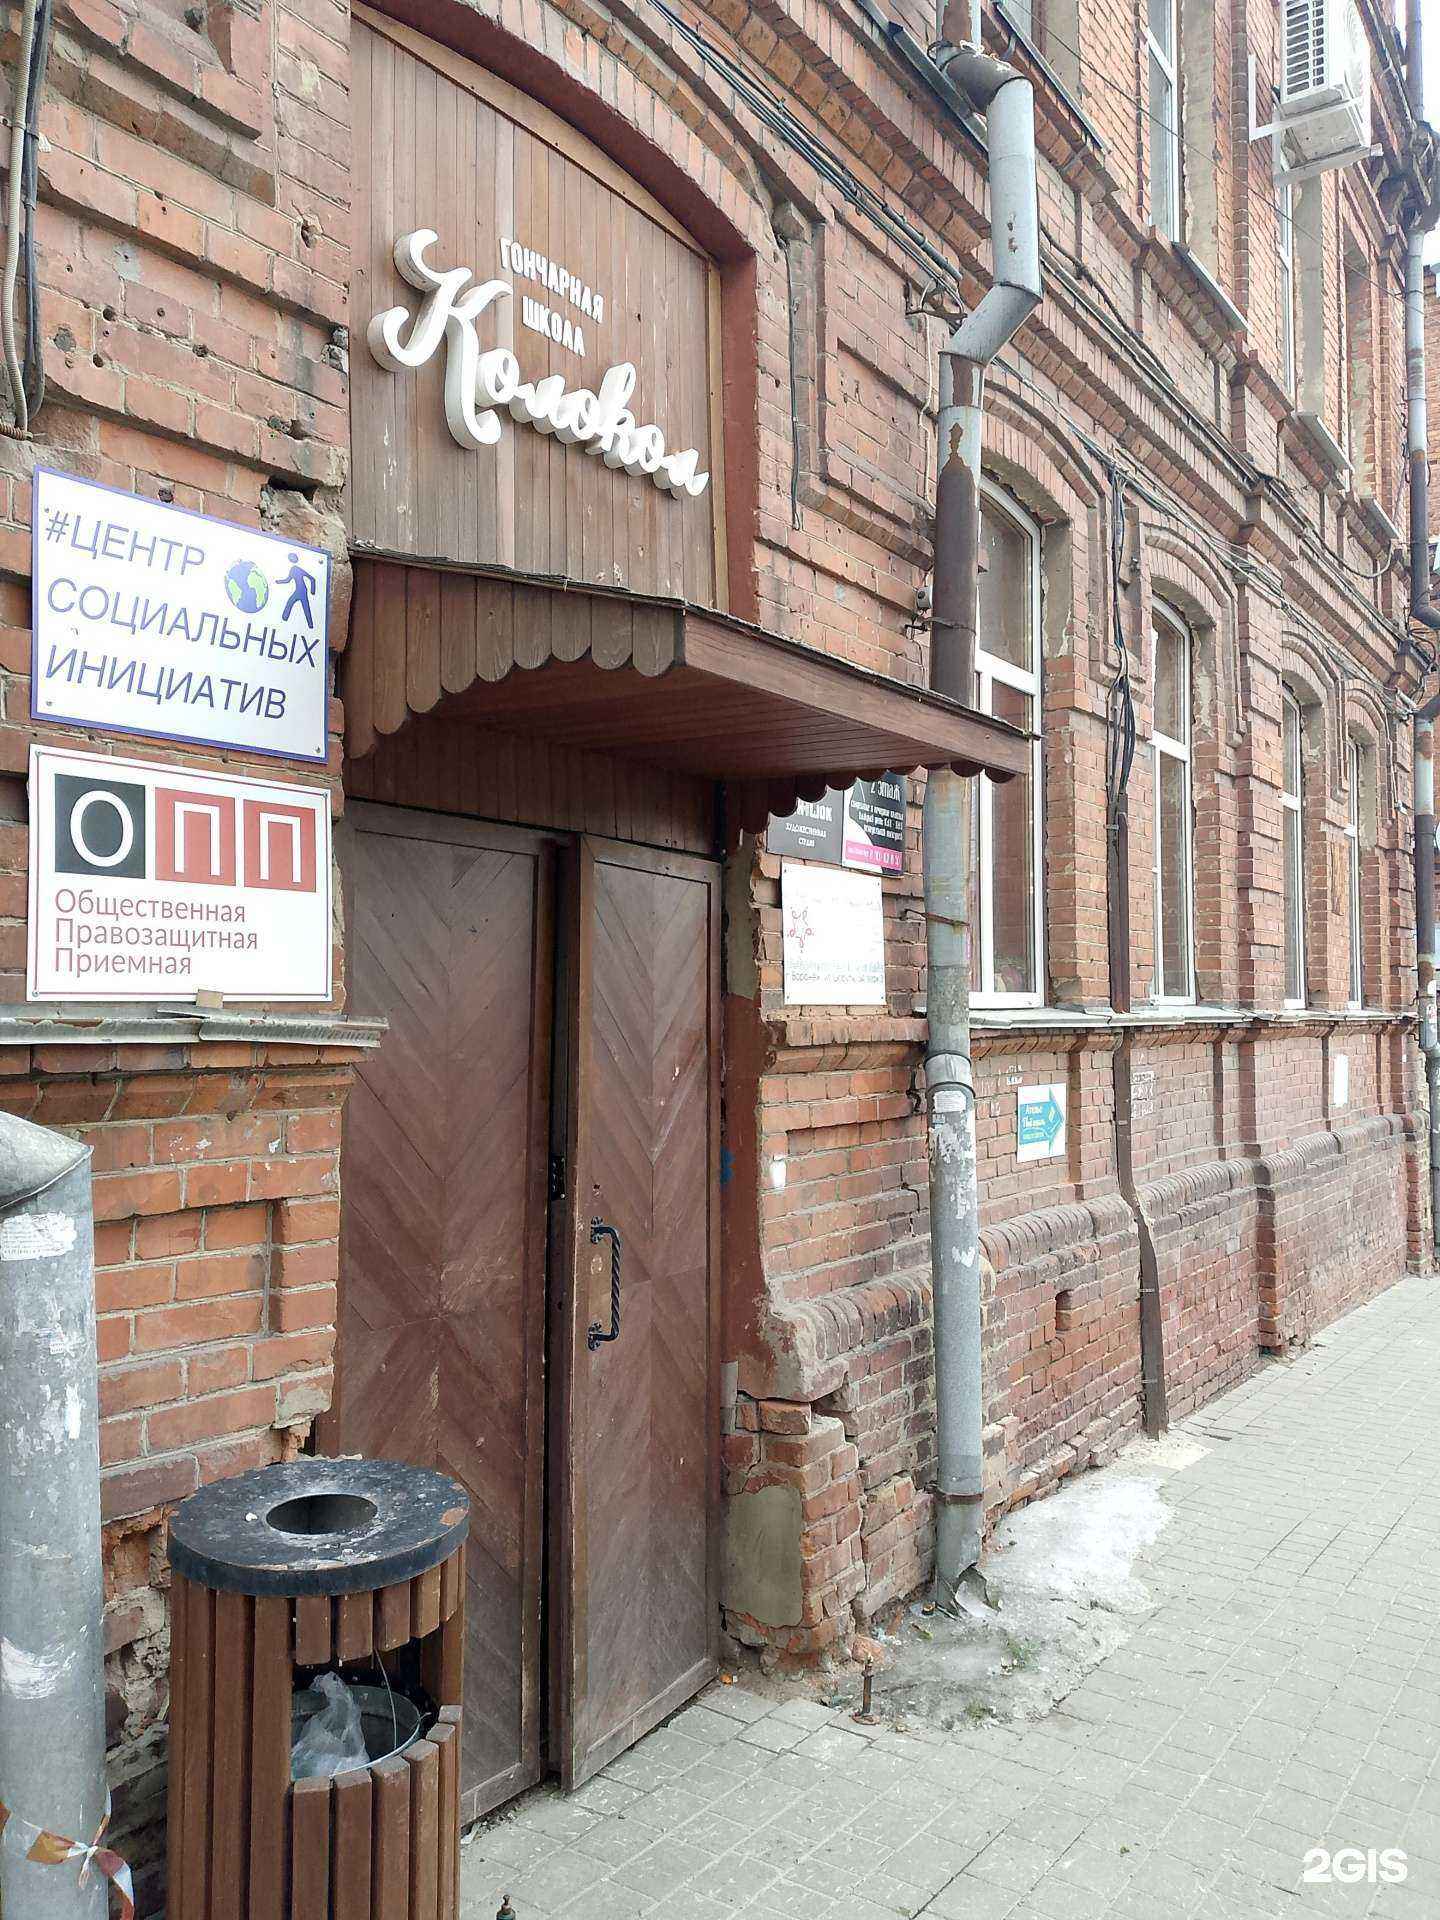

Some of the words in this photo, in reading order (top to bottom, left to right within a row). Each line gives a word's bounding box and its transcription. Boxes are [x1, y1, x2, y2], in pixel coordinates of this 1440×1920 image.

[499, 236, 604, 324] ГОНЧАРНАЯ
[521, 295, 586, 358] ШКОЛА
[46, 510, 206, 576] #ЦЕНТР
[47, 577, 320, 668] СОЦИАЛЬНЫХ
[46, 645, 287, 719] ИНИЦИАТИВ
[70, 790, 301, 883] ОПП
[55, 888, 246, 923] Общественная
[55, 918, 258, 951] Правозащитная
[55, 948, 192, 978] Приемная
